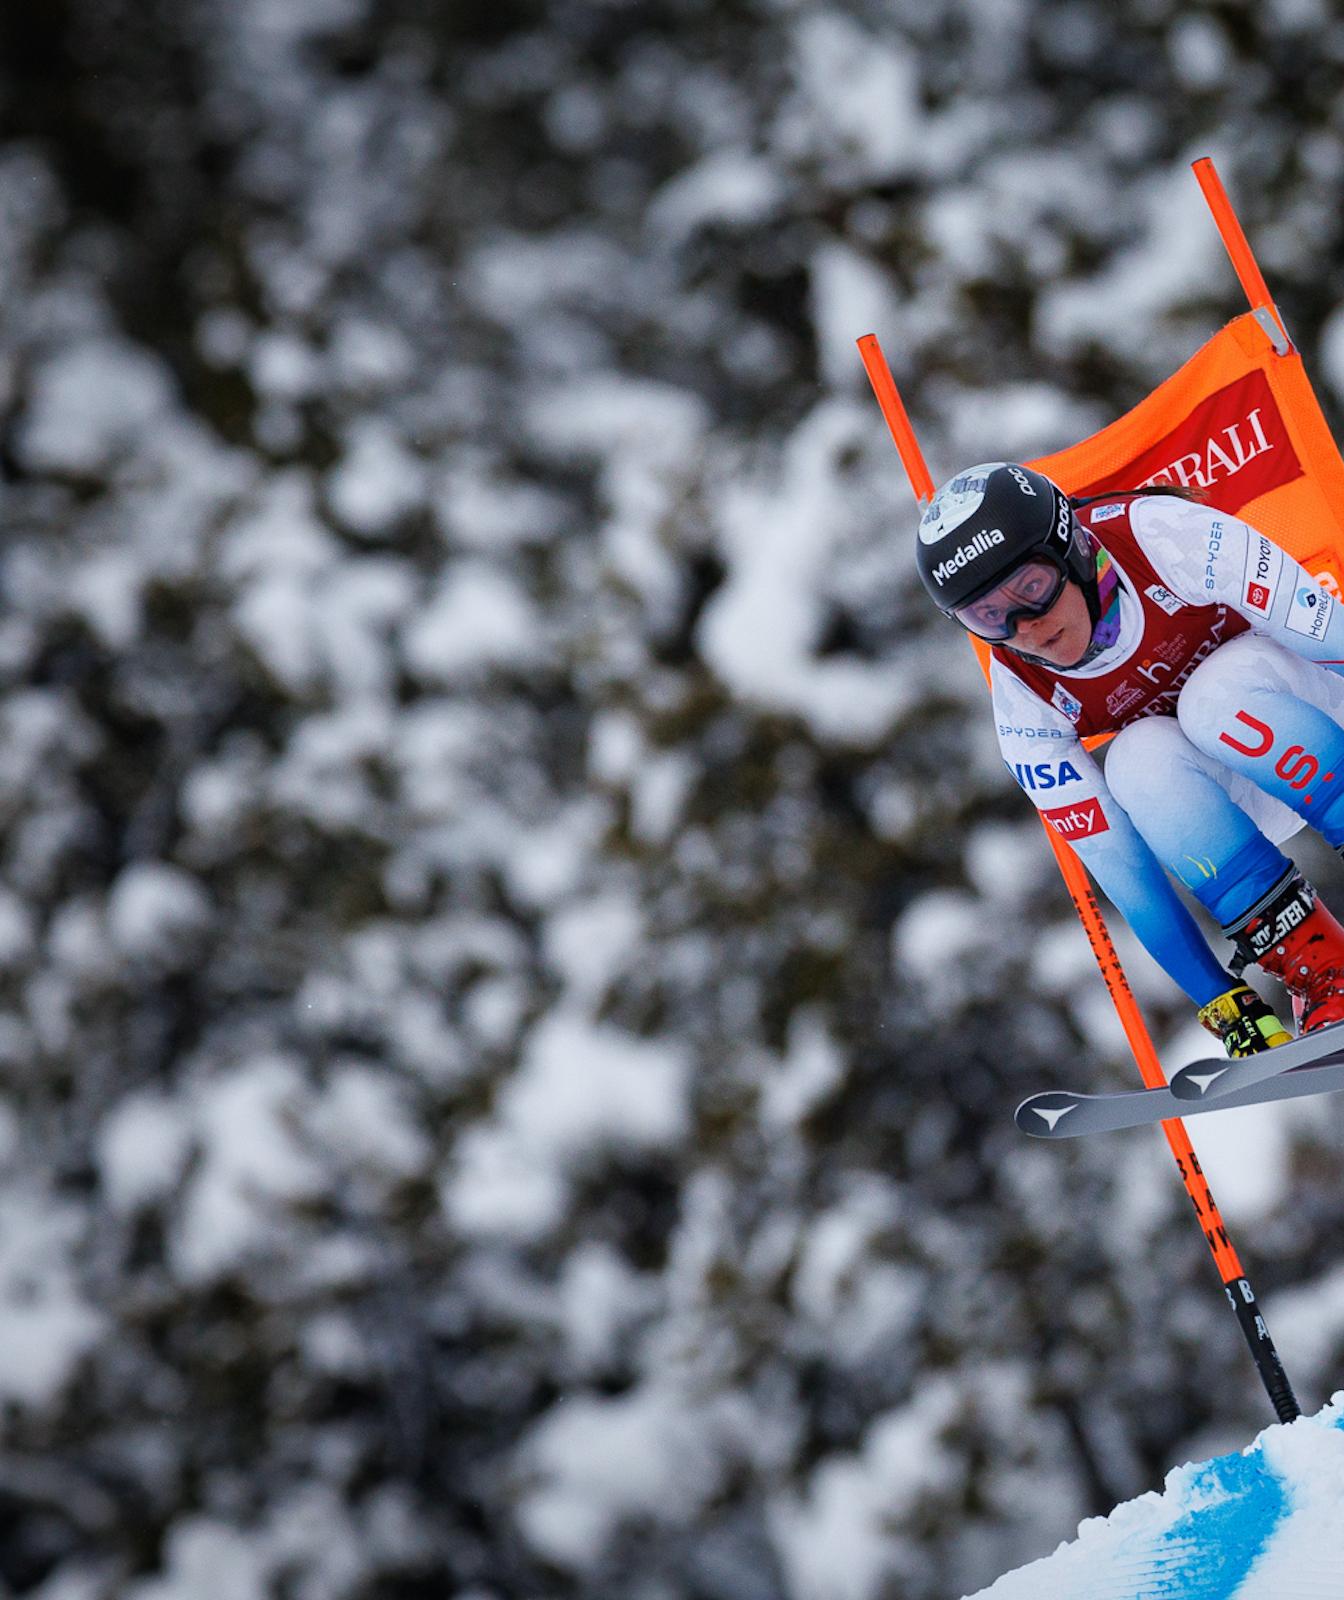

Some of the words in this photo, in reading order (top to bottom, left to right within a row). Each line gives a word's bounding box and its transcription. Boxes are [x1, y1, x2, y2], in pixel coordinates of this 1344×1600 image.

[932, 527, 1005, 587] Medallia
[1205, 521, 1224, 590] SPYDER
[999, 725, 1062, 738] SPYDER
[1004, 760, 1083, 790] VISA
[1242, 1016, 1257, 1037] LEKI
